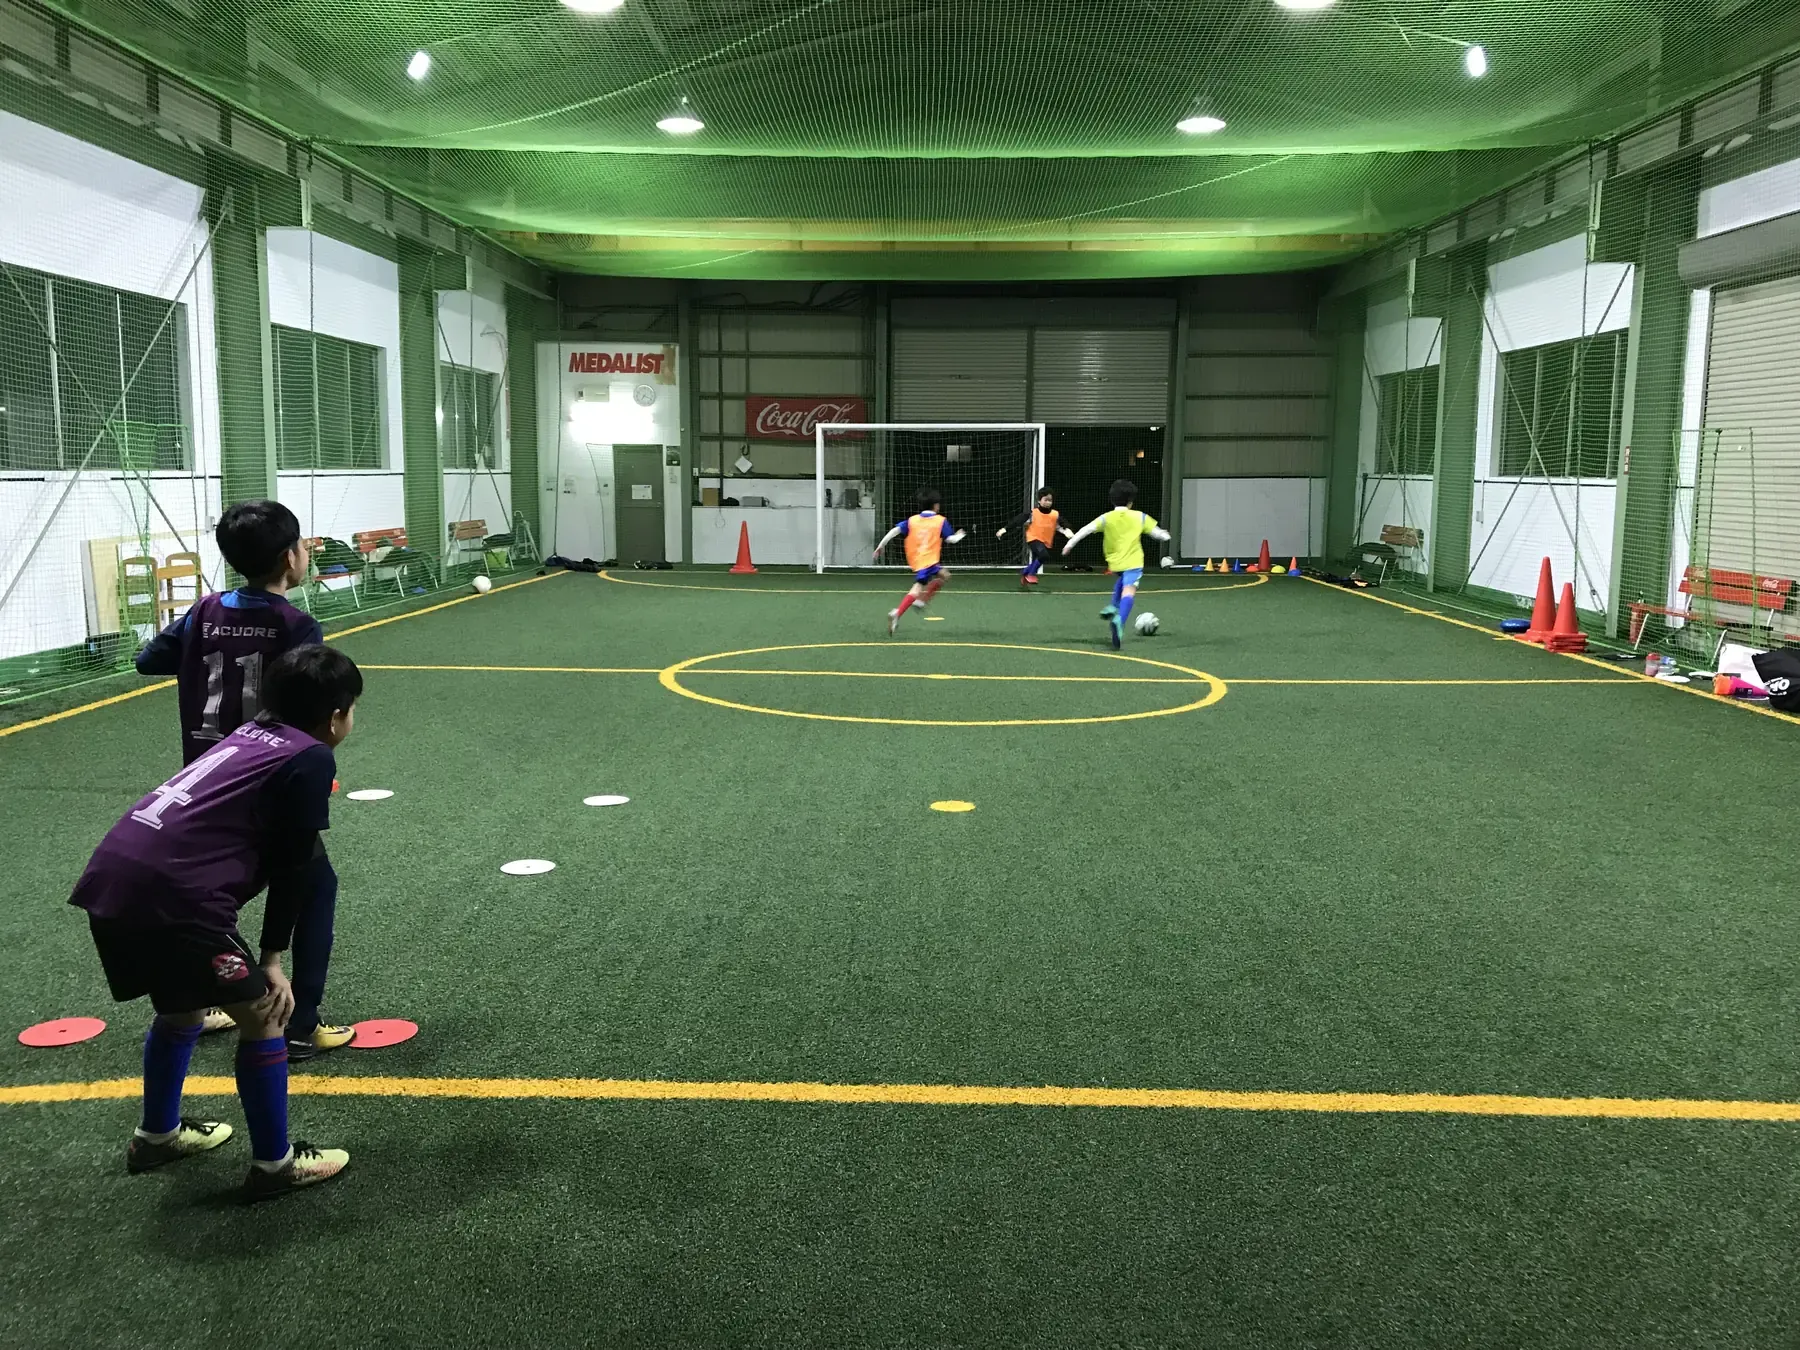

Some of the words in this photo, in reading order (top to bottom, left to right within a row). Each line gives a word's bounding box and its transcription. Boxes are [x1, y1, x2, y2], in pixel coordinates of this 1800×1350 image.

[568, 352, 665, 374] MEDALIST
[191, 649, 264, 741] 11
[130, 745, 240, 831] 4
